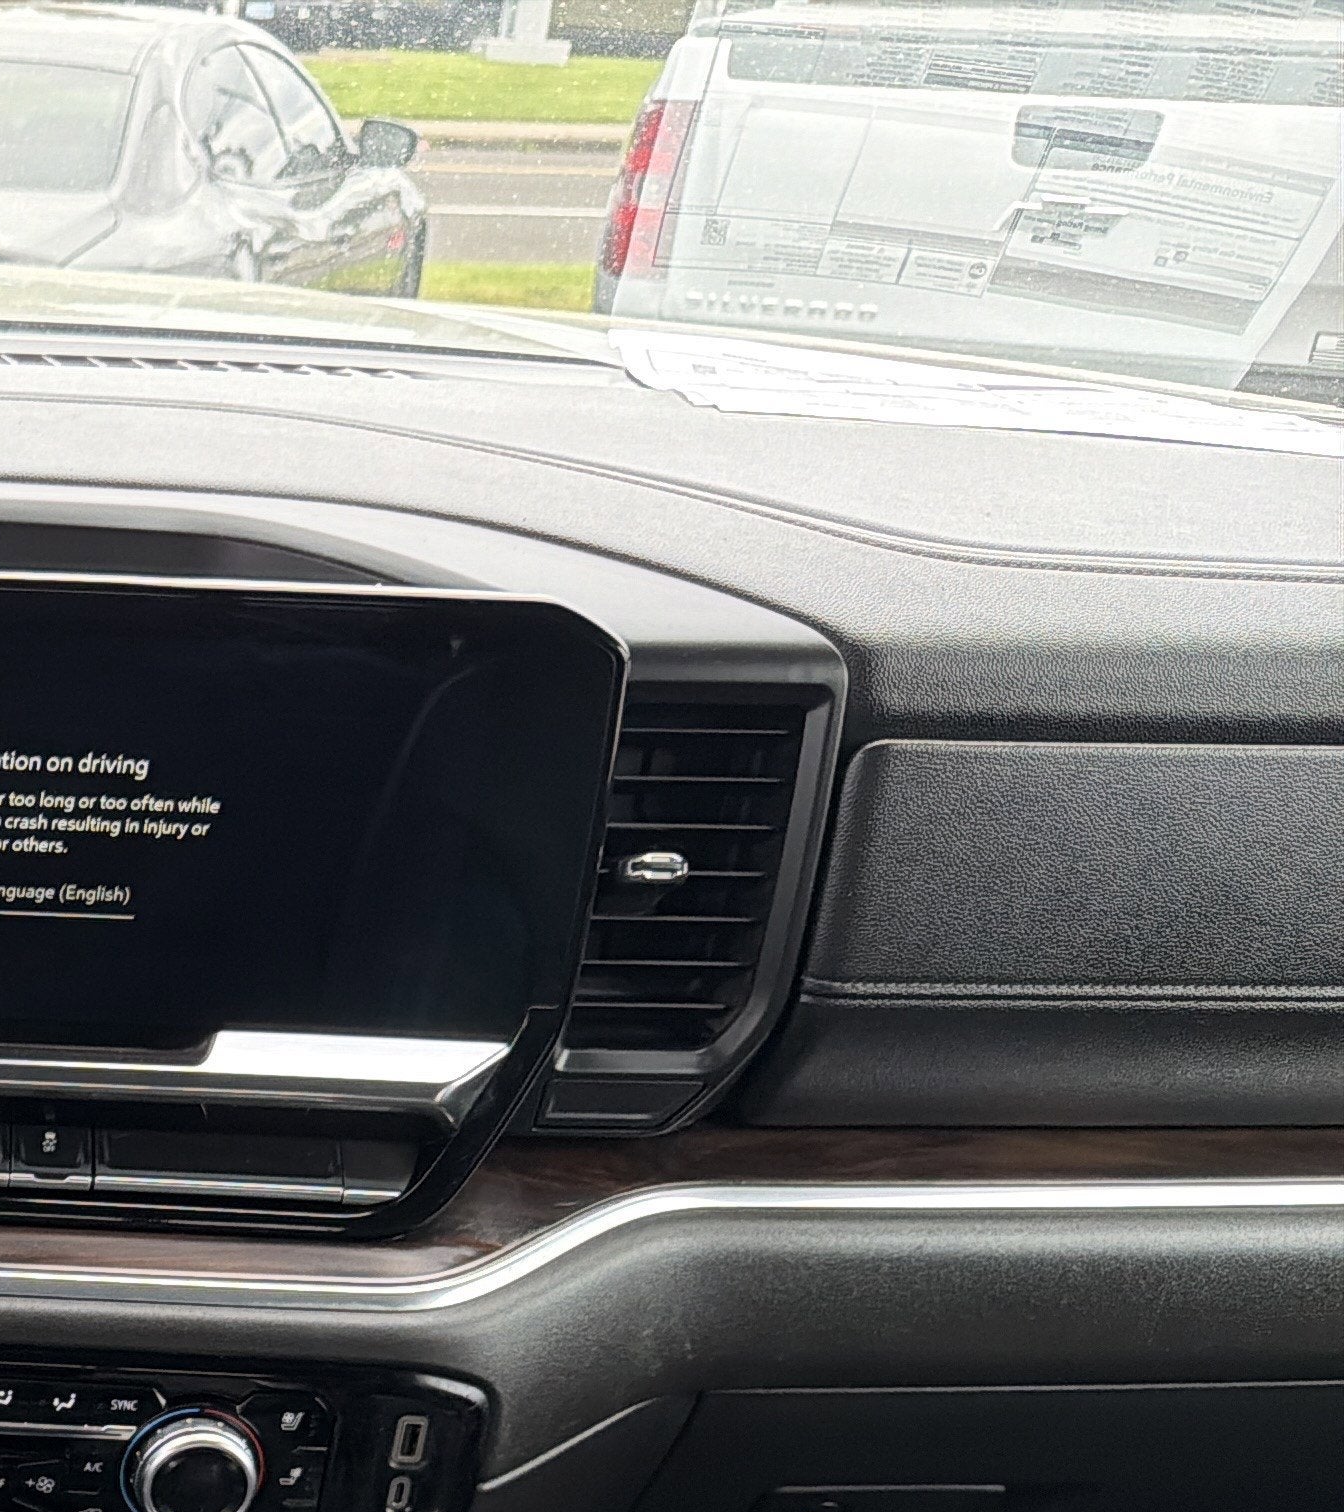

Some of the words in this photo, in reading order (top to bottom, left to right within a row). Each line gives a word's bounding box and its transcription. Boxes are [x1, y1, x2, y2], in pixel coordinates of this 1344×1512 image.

[46, 756, 74, 773] on
[78, 751, 150, 781] driving
[8, 791, 36, 808] too
[39, 790, 76, 813] long
[78, 796, 97, 810] or
[99, 794, 127, 810] too
[130, 793, 175, 813] often
[178, 796, 221, 814] while
[4, 813, 48, 831] crash
[50, 815, 122, 837] resulting
[124, 818, 140, 834] in
[143, 818, 189, 840] injury
[191, 822, 211, 836] or
[12, 834, 69, 854] others.
[58, 883, 131, 906] (English)
[110, 1399, 138, 1412] SYNC
[83, 1461, 104, 1473] A/C
